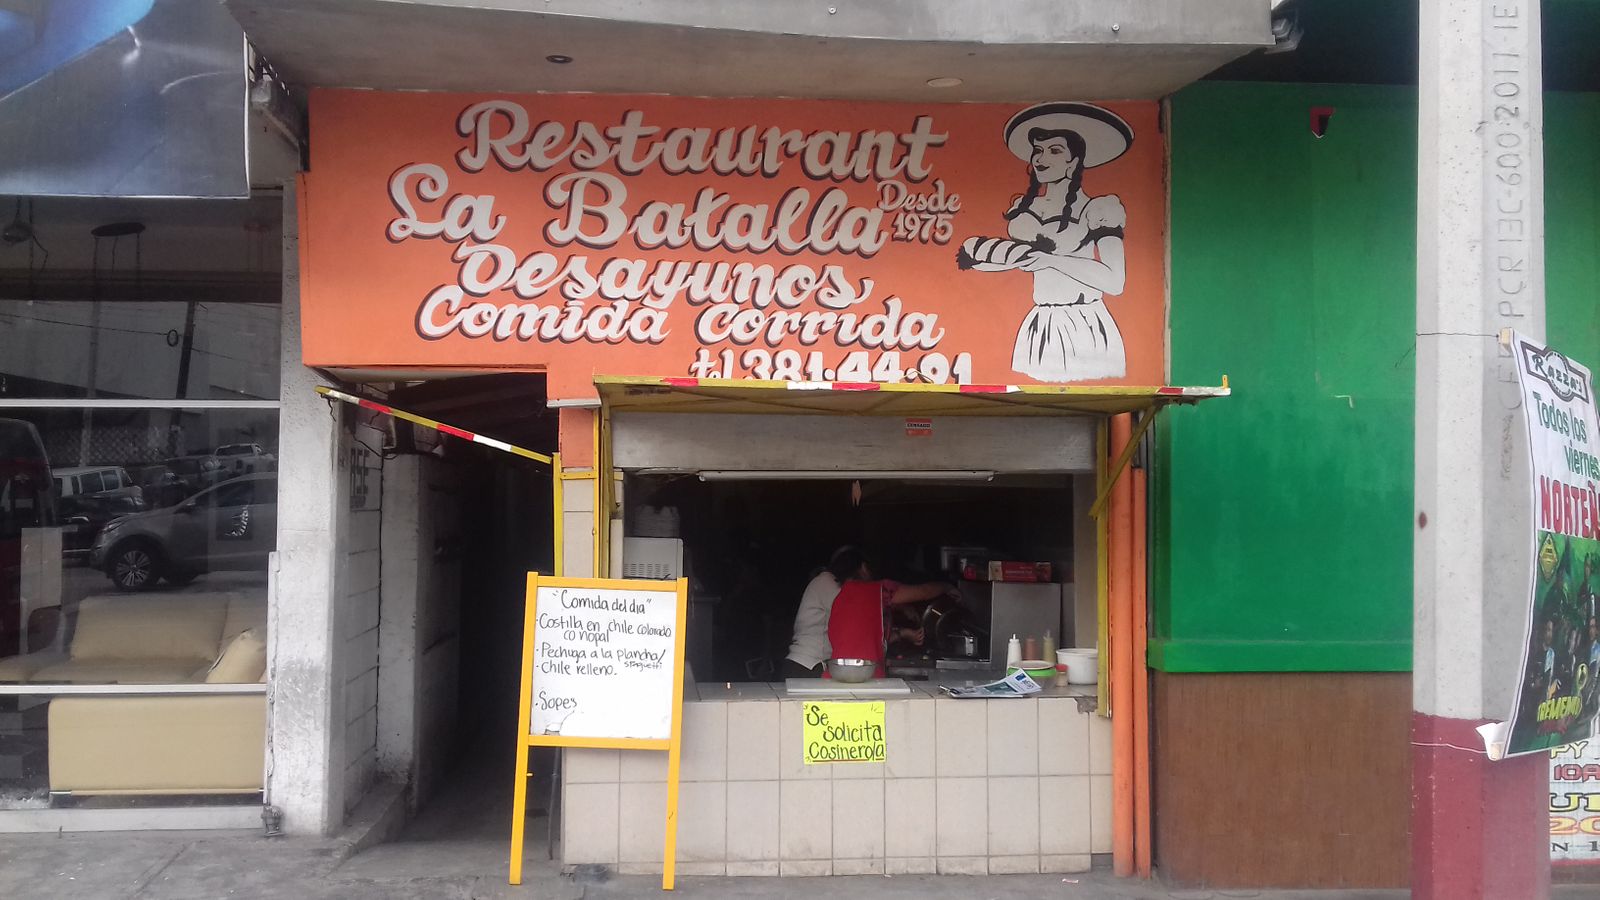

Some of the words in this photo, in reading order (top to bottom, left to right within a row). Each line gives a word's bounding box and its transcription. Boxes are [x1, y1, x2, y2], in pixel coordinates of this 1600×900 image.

[457, 100, 949, 182] Restaurant
[386, 162, 507, 243] La
[543, 171, 888, 259] Batalla
[877, 178, 961, 214] Desde
[891, 211, 955, 245] 1975
[418, 284, 672, 345] Comida
[1532, 390, 1570, 437] Todos
[1569, 407, 1588, 444] los
[1541, 474, 1600, 540] NORTEÑ
[611, 598, 627, 613] del
[579, 630, 610, 647] nopal
[586, 621, 600, 632] en
[590, 650, 598, 658] a
[601, 647, 613, 659] la
[806, 704, 830, 727] Se
